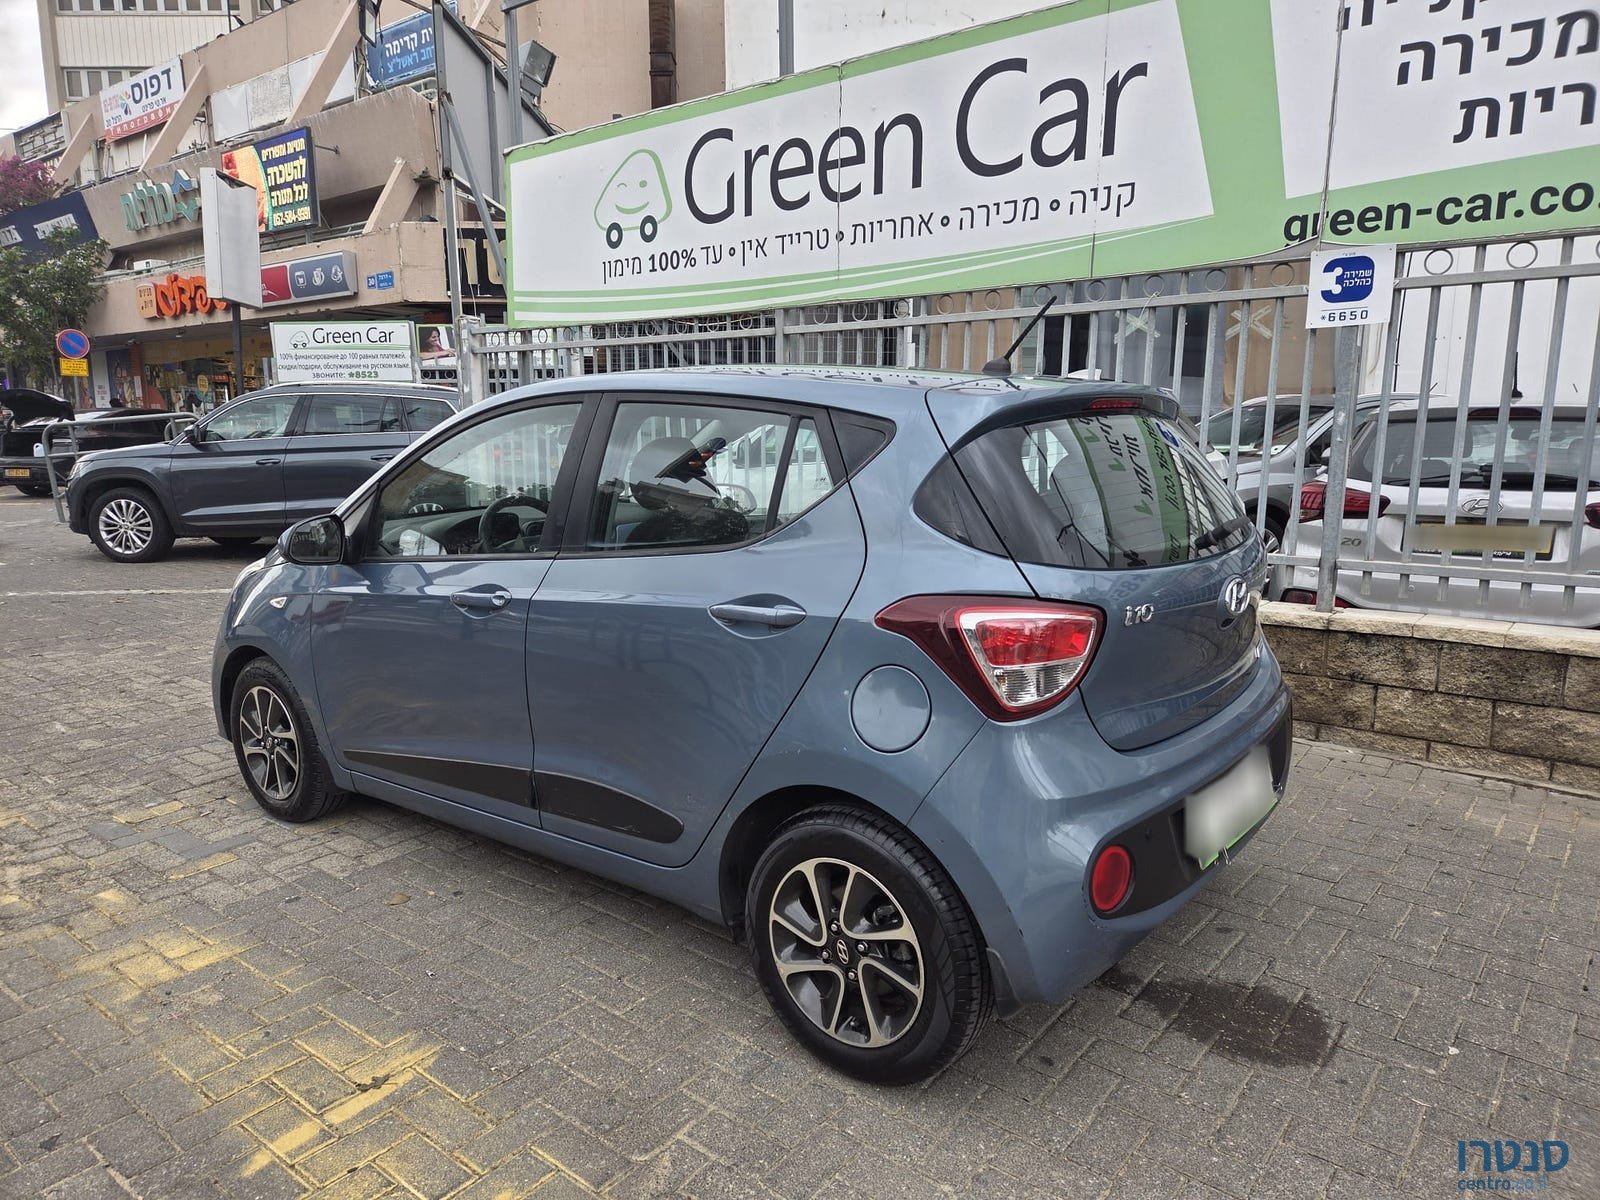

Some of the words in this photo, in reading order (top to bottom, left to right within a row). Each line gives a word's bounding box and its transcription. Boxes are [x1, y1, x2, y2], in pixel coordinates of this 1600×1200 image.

[421, 27, 433, 45] ית
[1397, 9, 1599, 86] מכירה
[420, 46, 434, 61] חב
[130, 67, 172, 105] דפוס
[684, 112, 923, 224] Green
[955, 57, 1148, 178] Car
[266, 155, 307, 187] להשכרה
[270, 187, 294, 208] מטרה
[292, 181, 309, 201] לכל
[1069, 182, 1135, 218] קניה
[959, 196, 1040, 231] מכירה
[1283, 182, 1600, 246] green-car.co
[775, 227, 830, 255] טרייד
[850, 212, 934, 246] אחריות
[648, 247, 697, 273] 100%
[701, 243, 723, 266] עד
[740, 236, 768, 267] אין
[602, 256, 642, 285] מימון
[1343, 278, 1372, 288] כהלכה
[1344, 269, 1373, 279] שמירה
[312, 327, 362, 344] Green
[366, 326, 395, 343] Car
[279, 352, 293, 360] 100%
[294, 353, 339, 361] финансирование
[340, 353, 348, 361] до
[349, 352, 358, 360] 100
[359, 353, 379, 361] равных
[323, 362, 361, 371] обслуживание
[371, 363, 393, 371] русском
[1124, 603, 1155, 627] i10
